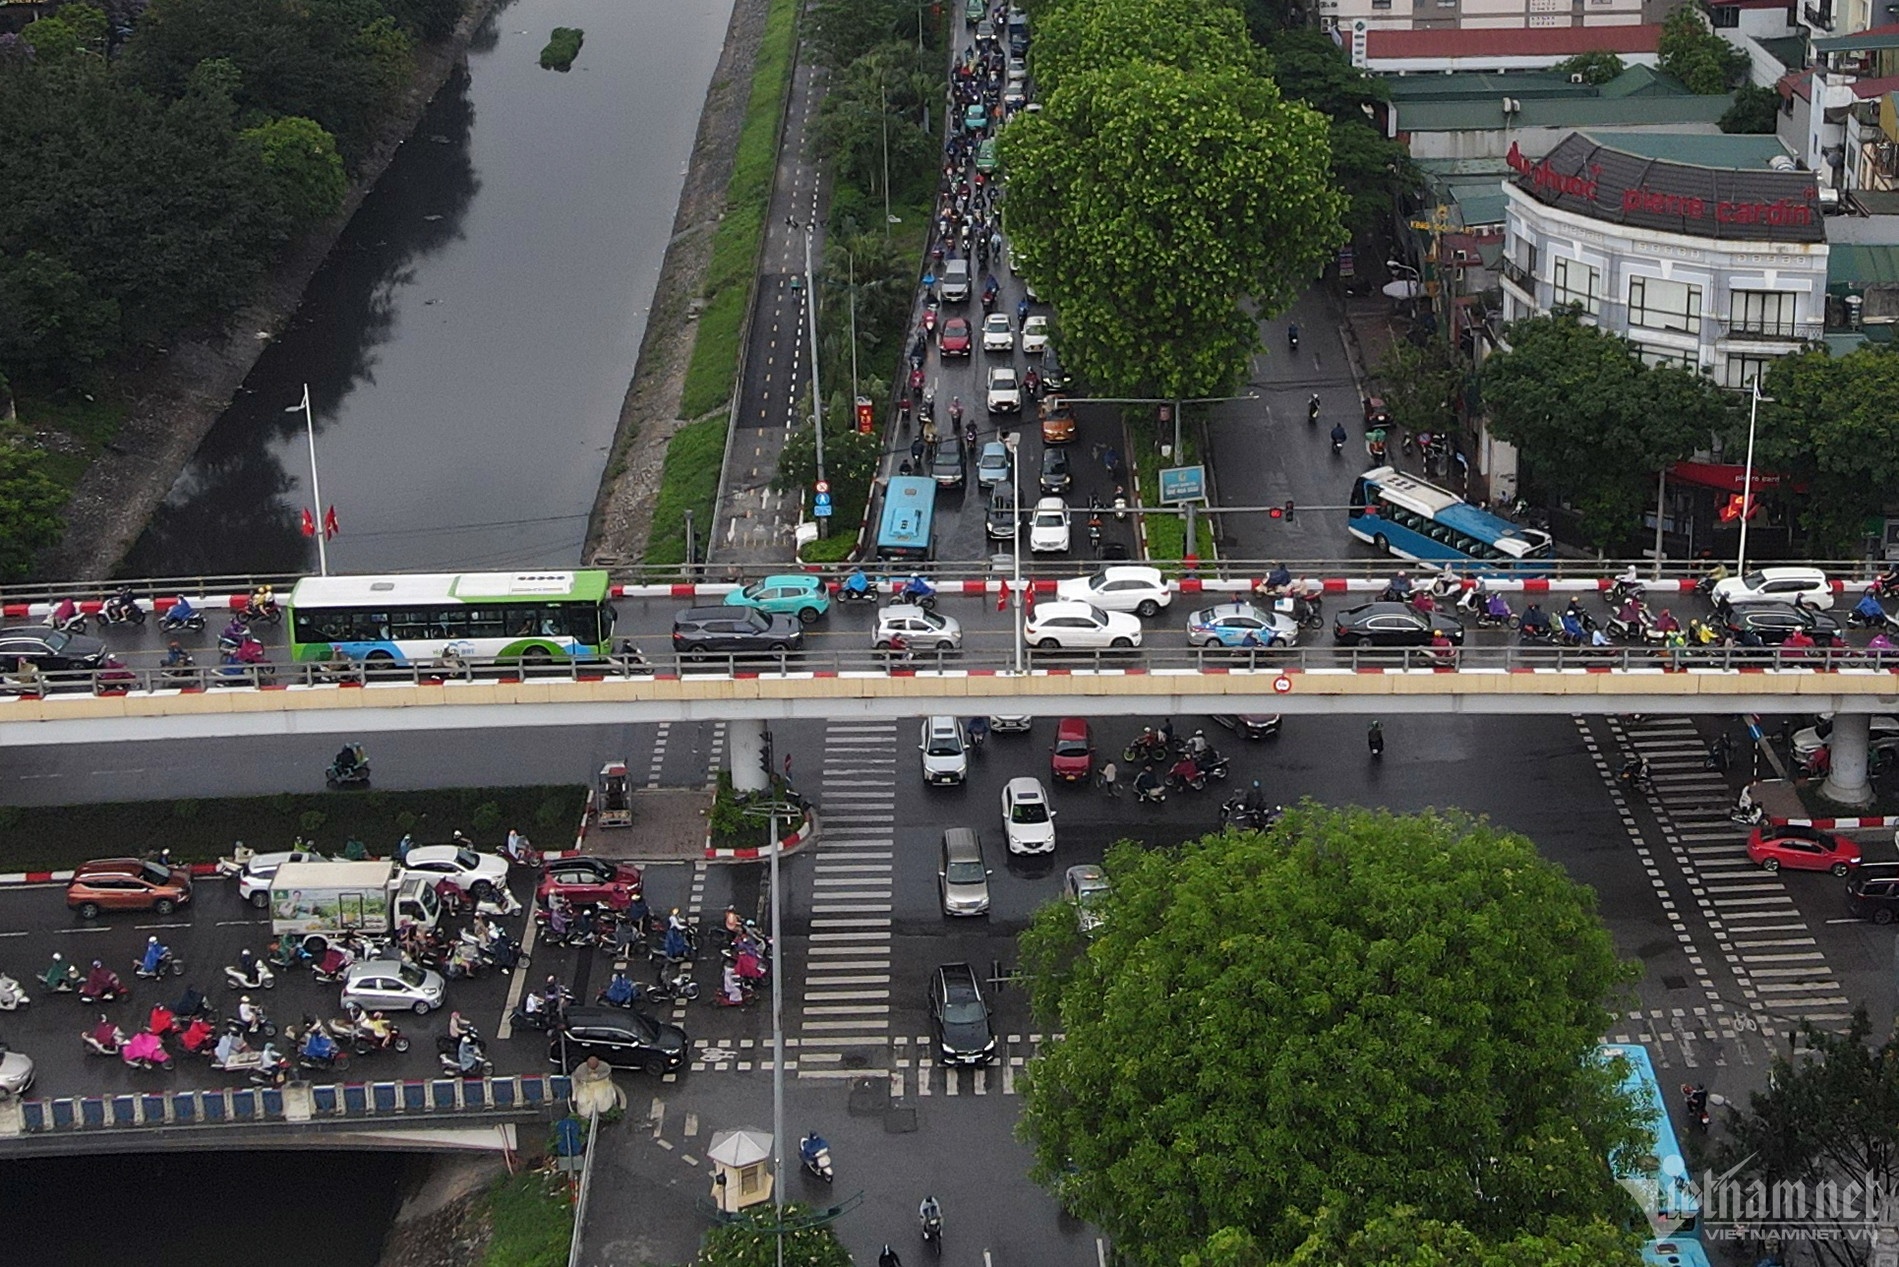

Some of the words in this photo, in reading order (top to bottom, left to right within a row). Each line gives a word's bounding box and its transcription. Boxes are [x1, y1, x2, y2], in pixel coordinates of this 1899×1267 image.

[1623, 185, 1704, 215] pierre
[1716, 197, 1811, 226] cardin
[1735, 474, 1759, 482] piere
